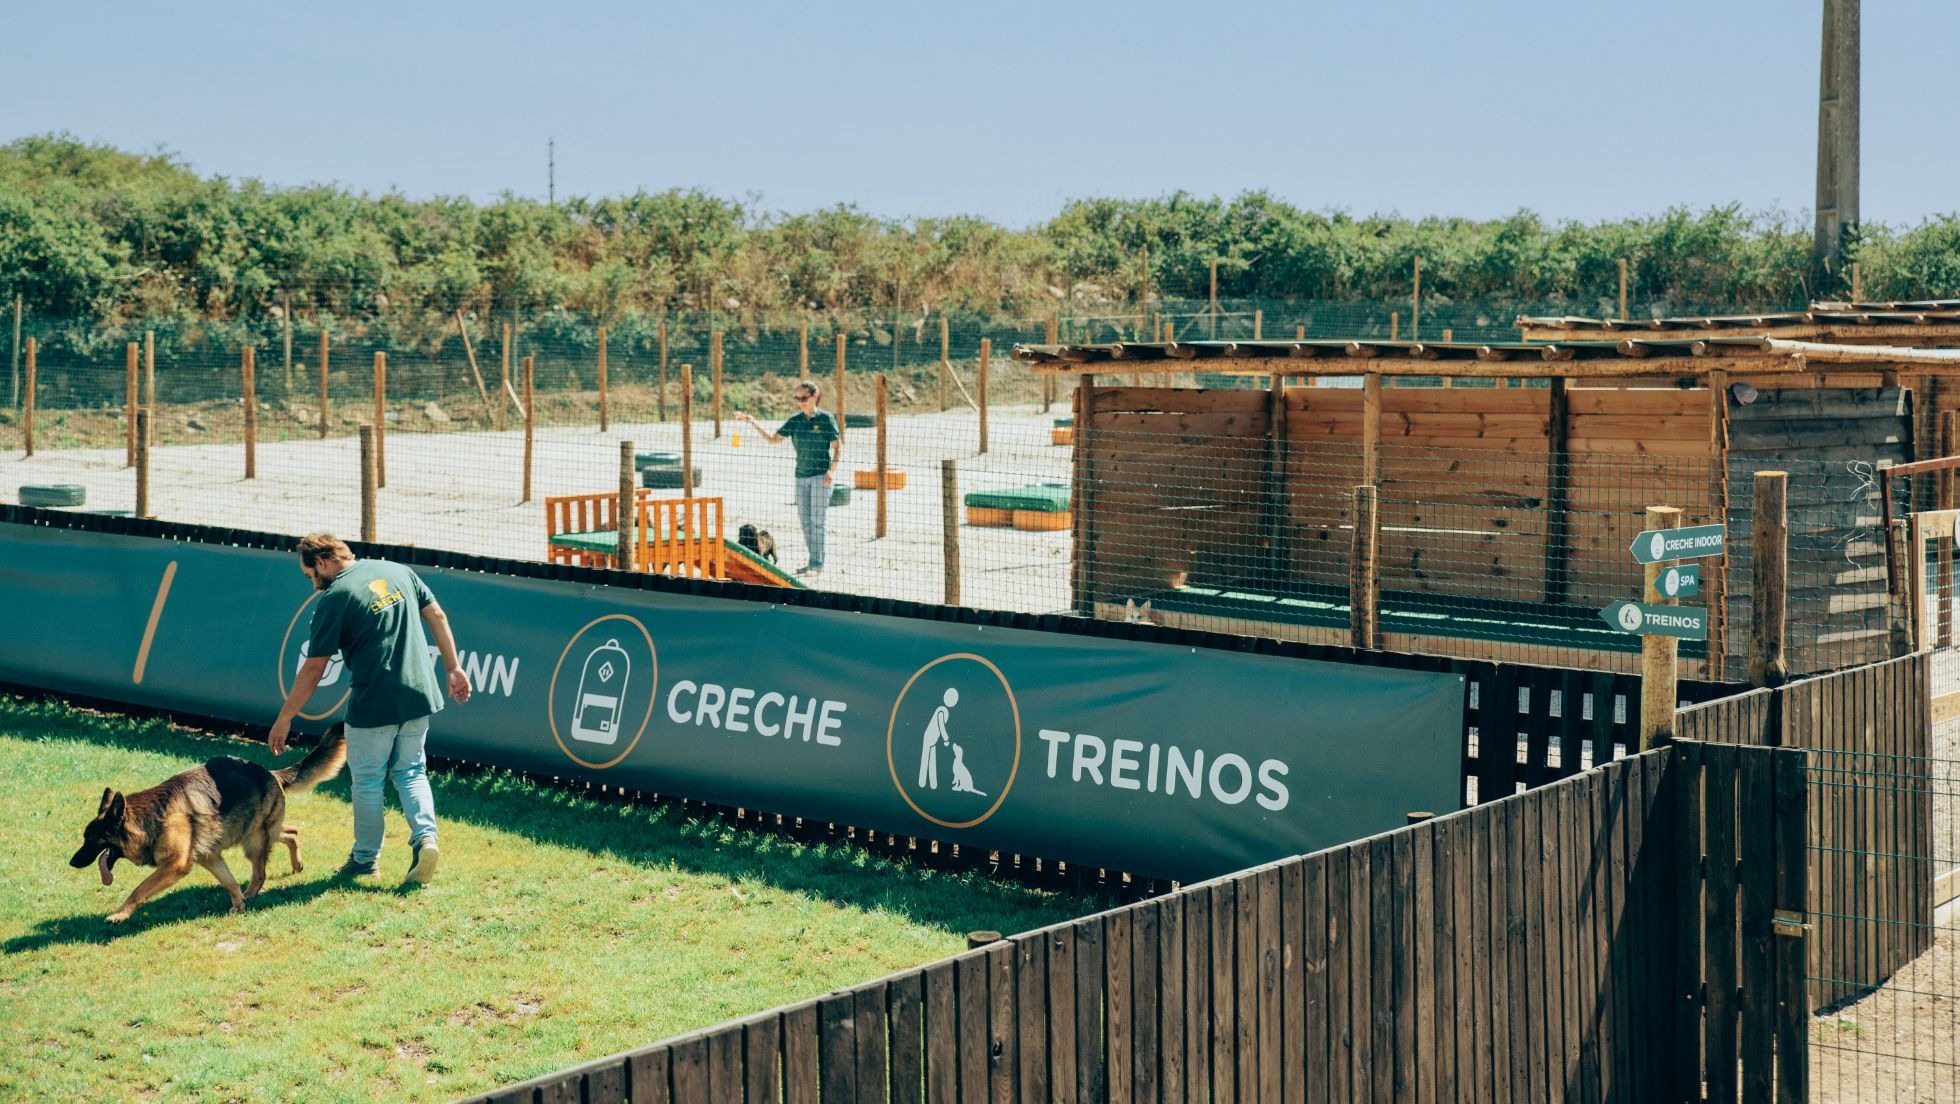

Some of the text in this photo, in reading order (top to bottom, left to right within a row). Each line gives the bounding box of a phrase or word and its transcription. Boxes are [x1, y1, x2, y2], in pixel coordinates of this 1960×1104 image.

[1665, 534, 1722, 551] CRECHE INDOOR
[1680, 575, 1695, 587] SPA
[1644, 613, 1700, 629] TREINOS
[667, 680, 847, 747] CRECHE
[1038, 729, 1290, 811] TREINOS
